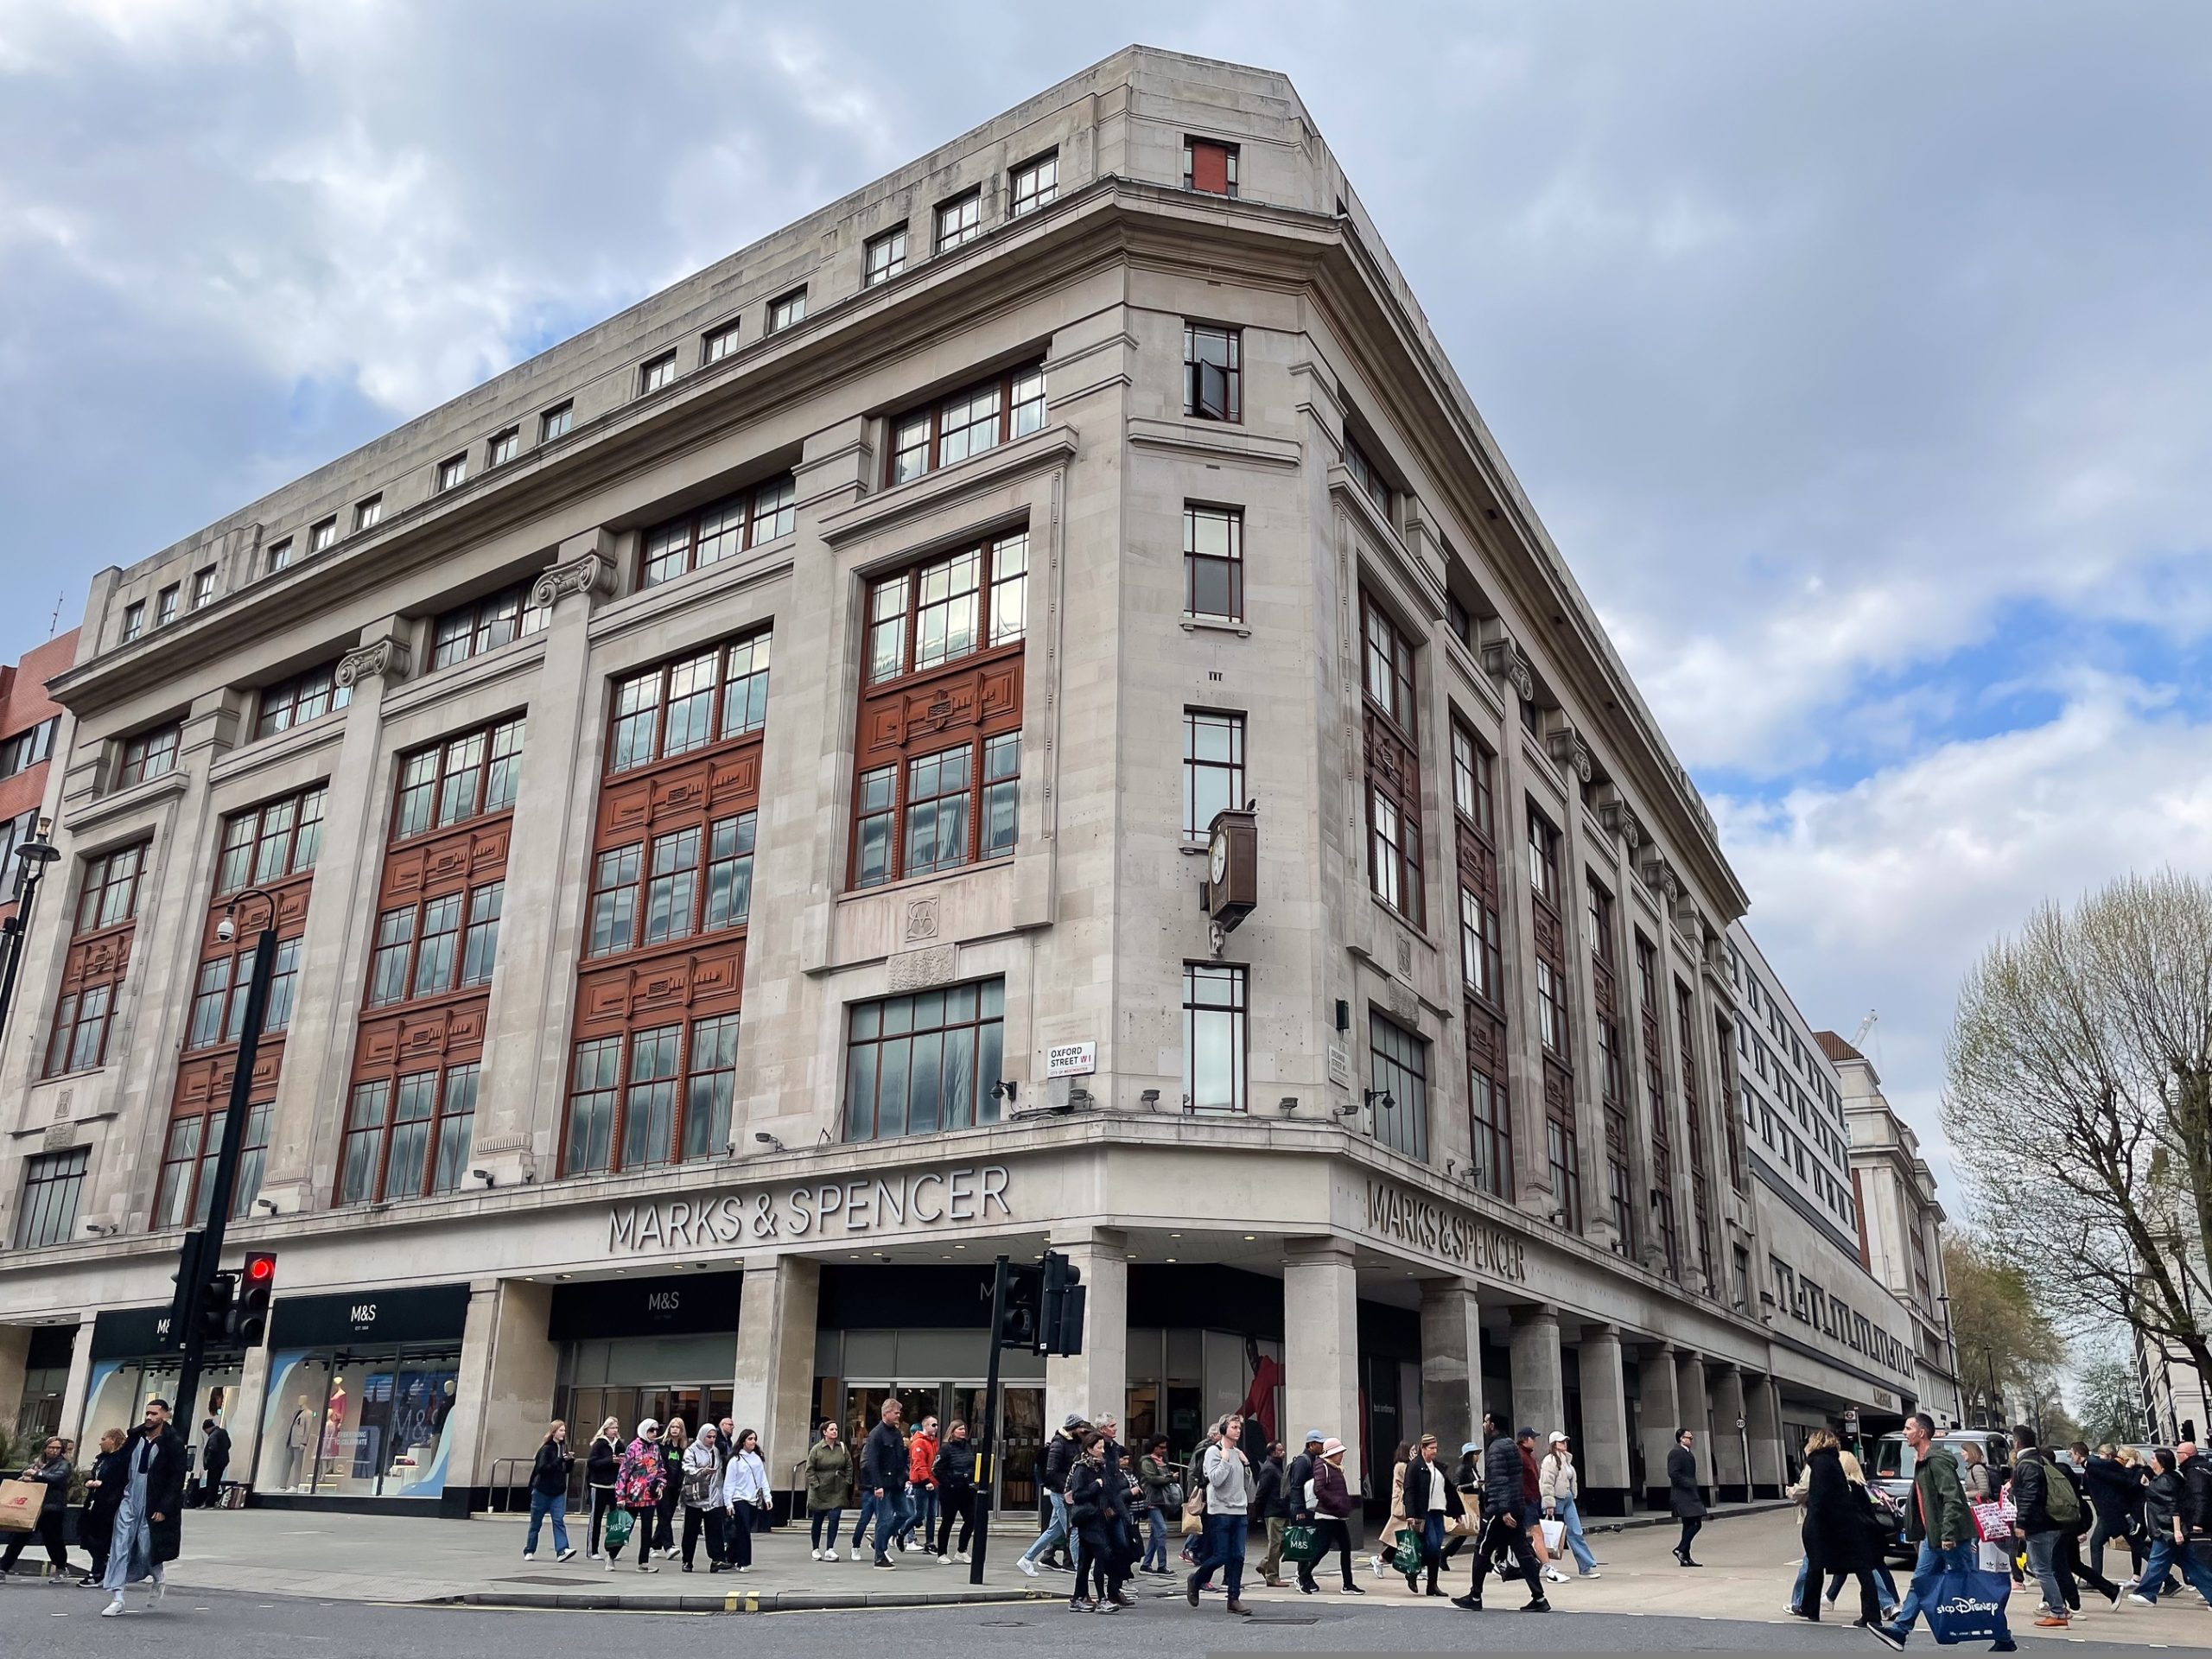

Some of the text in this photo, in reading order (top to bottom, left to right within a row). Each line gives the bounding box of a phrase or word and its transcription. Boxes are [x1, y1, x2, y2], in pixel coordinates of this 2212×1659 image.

[1051, 1046, 1082, 1058] OXFORD
[1051, 1056, 1078, 1067] STREET
[608, 1166, 1011, 1252] MARKS & SPENCER
[1366, 1179, 1526, 1283] MARKS & SPENCER
[648, 1291, 679, 1311] M&S
[351, 1304, 377, 1322] M&S
[1290, 1541, 1308, 1549] M&S
